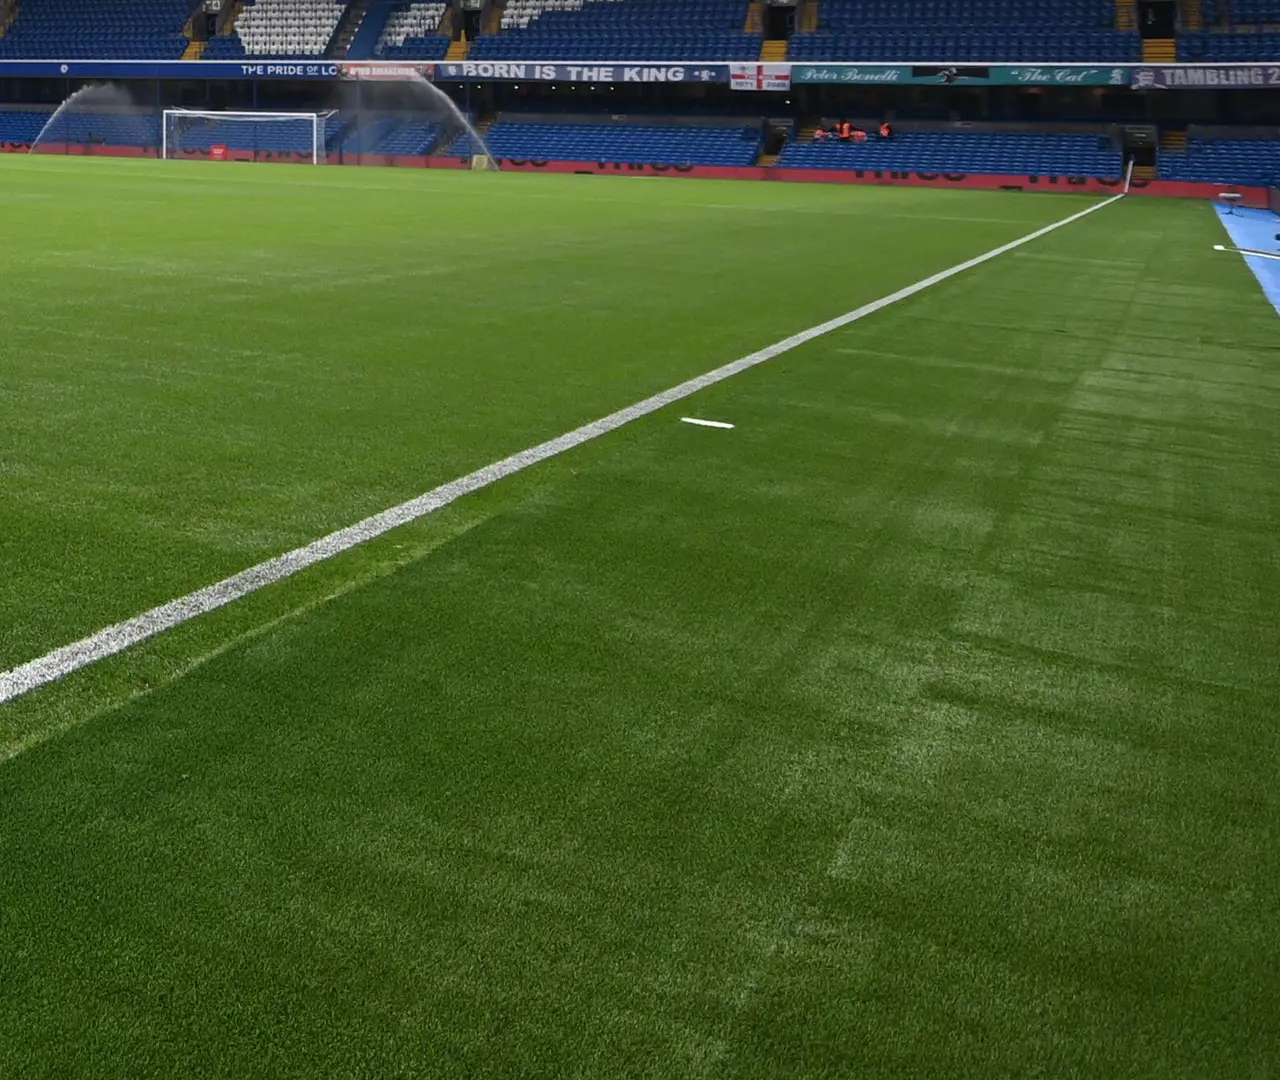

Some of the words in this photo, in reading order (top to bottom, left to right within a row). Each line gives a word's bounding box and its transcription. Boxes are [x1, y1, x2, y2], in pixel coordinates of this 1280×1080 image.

[241, 65, 264, 75] THE
[268, 65, 304, 75] PRIDE
[307, 65, 319, 76] OF
[463, 63, 526, 78] BORN
[534, 65, 557, 80] IS
[566, 67, 614, 81] THE
[623, 67, 685, 82] KING
[801, 68, 838, 81] Peter
[840, 69, 900, 82] Bonetti
[1162, 69, 1265, 85] TAMBLING
